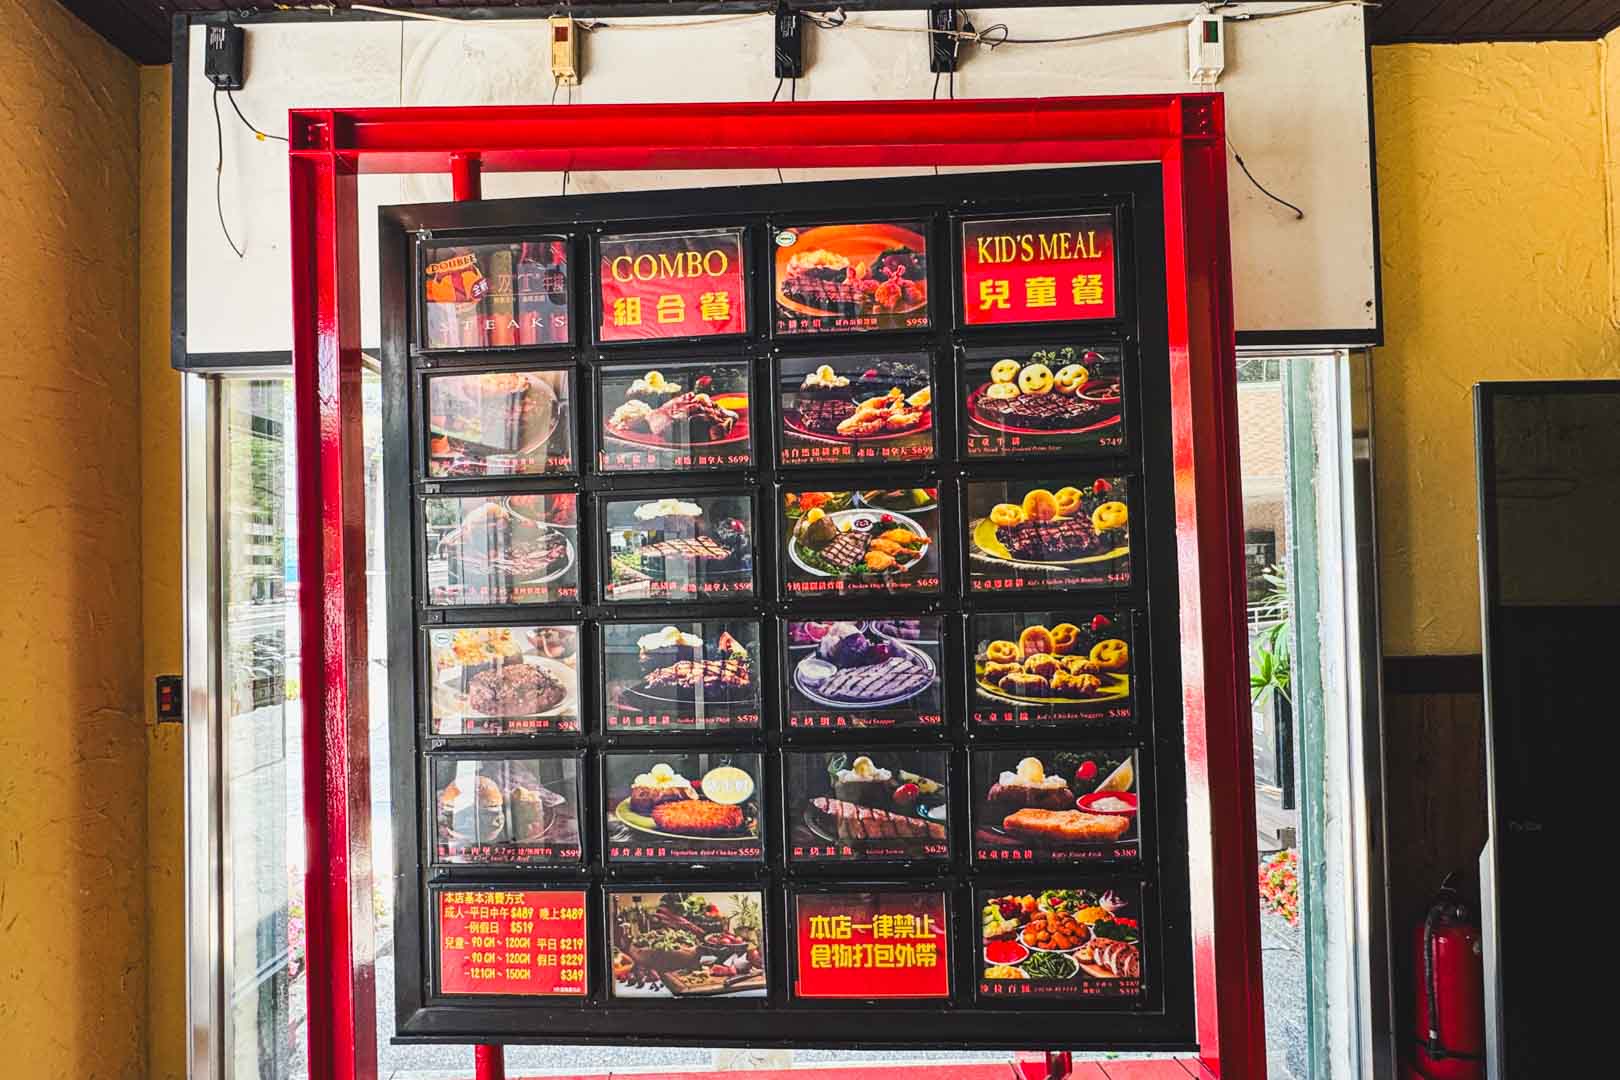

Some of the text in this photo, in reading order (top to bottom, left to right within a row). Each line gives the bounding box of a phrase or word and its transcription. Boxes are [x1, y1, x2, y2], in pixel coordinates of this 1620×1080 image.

[977, 230, 1102, 264] KID'S MEAL
[431, 255, 476, 272] DOUBLE
[611, 249, 728, 282] COMBO
[979, 274, 1104, 310] 兒童餐
[614, 291, 731, 327] 組合餐
[440, 315, 565, 332] STEAKS
[444, 892, 525, 905] 本店基本消費方式
[510, 921, 534, 934] $519
[809, 914, 937, 939] 本店一律禁止
[537, 938, 557, 951] 平日
[560, 938, 584, 951] $219
[537, 954, 557, 966] 假日
[560, 954, 584, 966] $229
[811, 943, 937, 968] 食物打包外帶
[560, 969, 584, 982] $349
